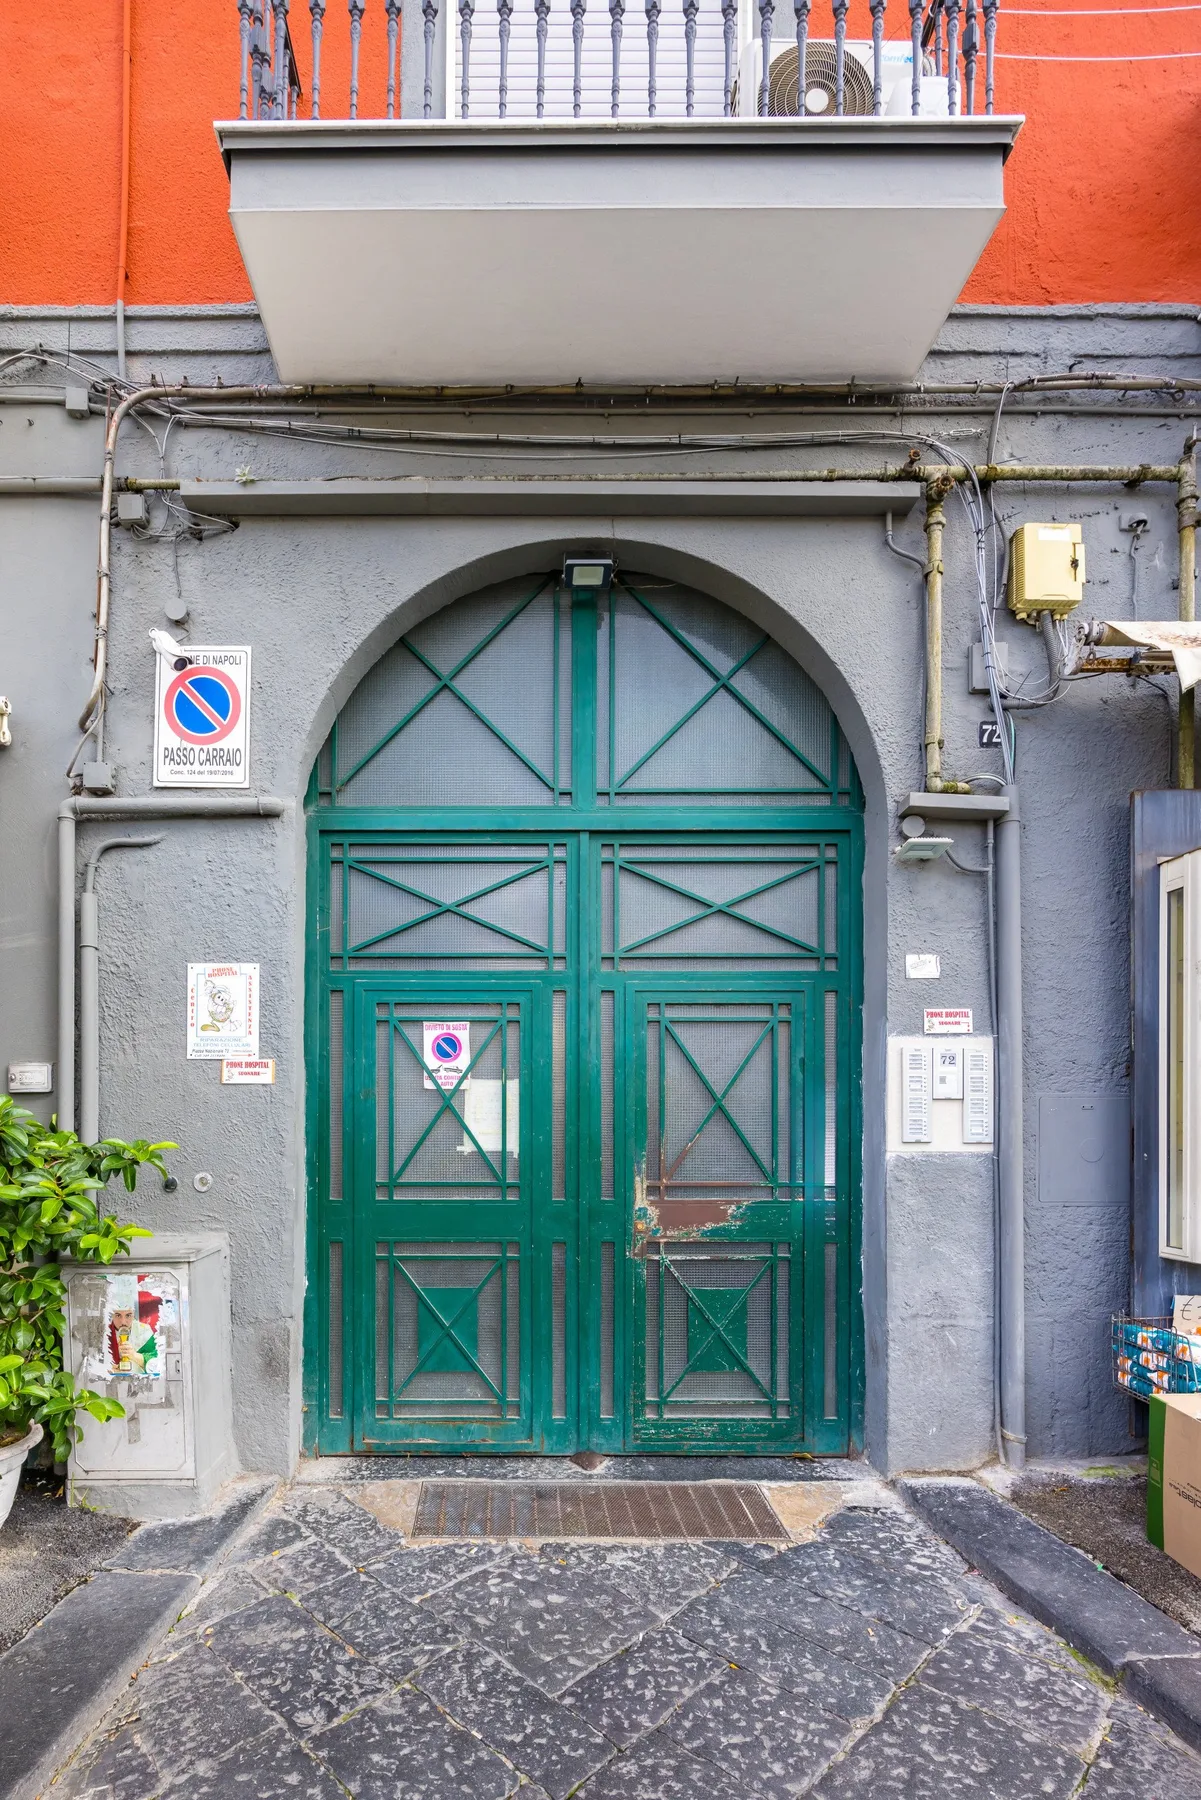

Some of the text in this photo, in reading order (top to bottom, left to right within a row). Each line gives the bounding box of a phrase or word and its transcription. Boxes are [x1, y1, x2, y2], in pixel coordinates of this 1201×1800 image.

[202, 655, 211, 665] DI
[212, 655, 242, 666] NAPOLI
[982, 724, 1002, 743] 72
[163, 747, 242, 767] PASSO CARRAIO
[207, 970, 238, 978] HOSPITAL
[244, 1061, 269, 1069] HOSPITAL
[940, 1055, 956, 1065] 72
